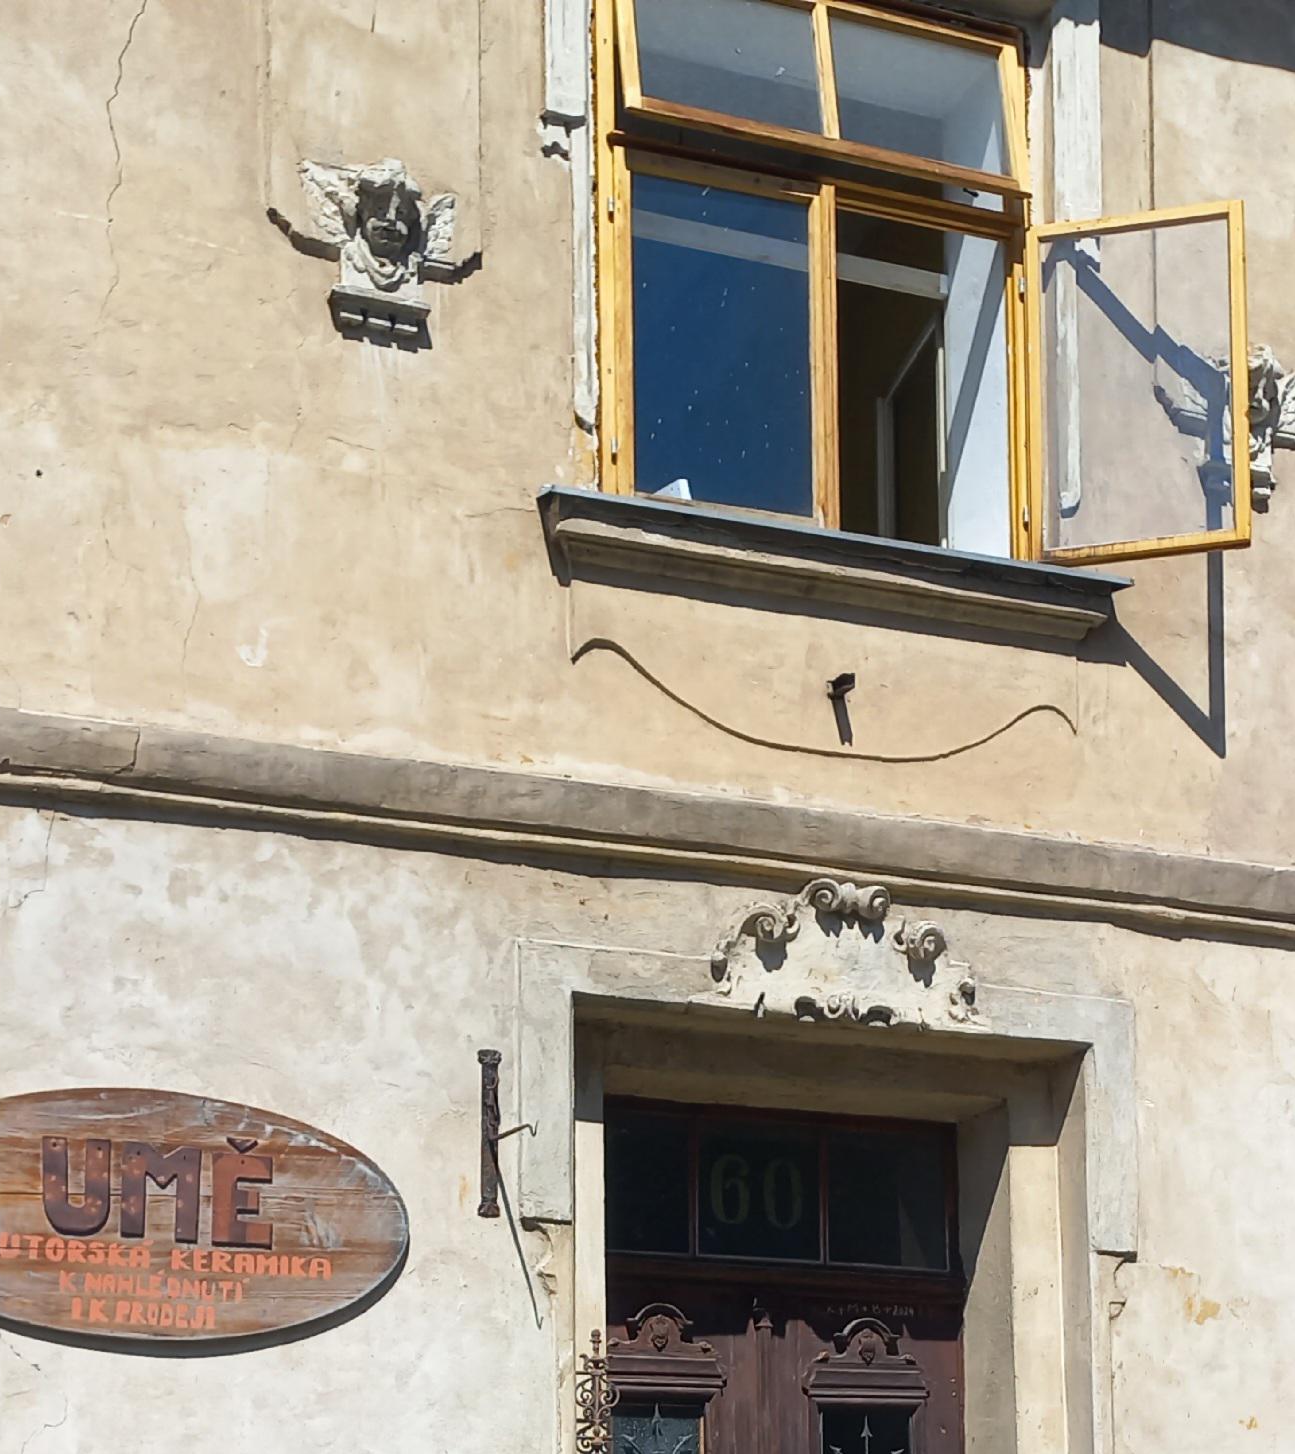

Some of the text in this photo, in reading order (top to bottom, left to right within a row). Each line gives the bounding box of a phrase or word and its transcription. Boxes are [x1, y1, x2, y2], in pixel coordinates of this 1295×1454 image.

[42, 1136, 274, 1250] UMĚ
[710, 1154, 803, 1230] 60
[58, 1270, 77, 1293] K
[170, 1250, 333, 1280] KERAMIKA
[71, 1297, 217, 1330] I K PRODEJI
